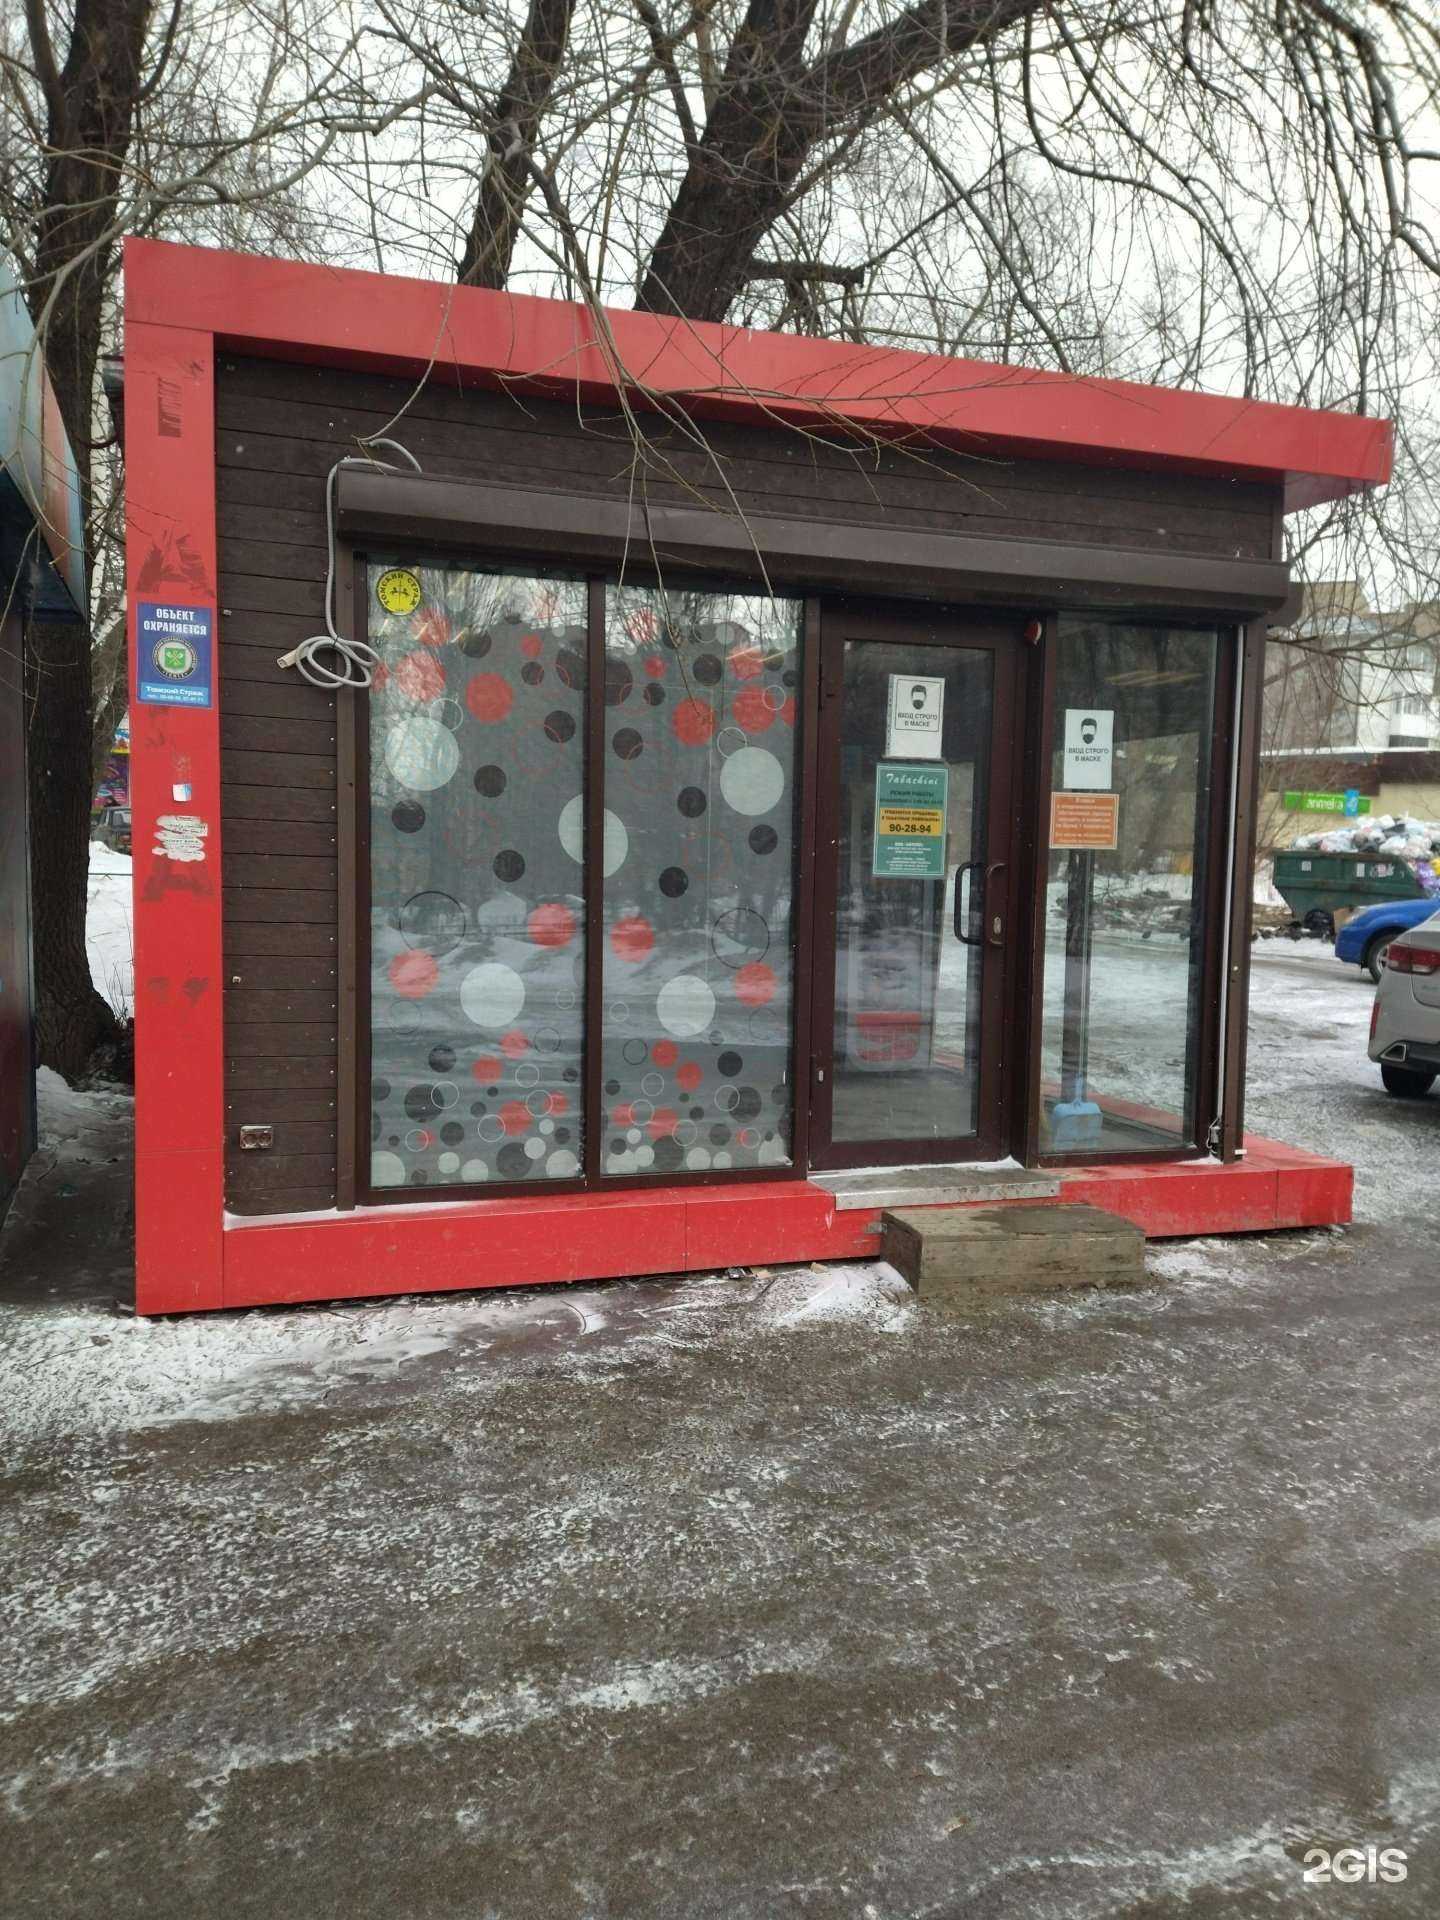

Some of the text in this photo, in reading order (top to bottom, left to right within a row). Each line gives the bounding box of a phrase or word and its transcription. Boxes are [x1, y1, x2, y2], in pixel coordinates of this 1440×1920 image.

[156, 608, 194, 621] ОБЪЕКТ
[143, 621, 207, 635] ОХРАНЯЕТСЯ
[897, 712, 938, 721] ВХОД СТРОГО
[1086, 747, 1109, 755] СТРОГО
[889, 823, 932, 834] 90-28-94
